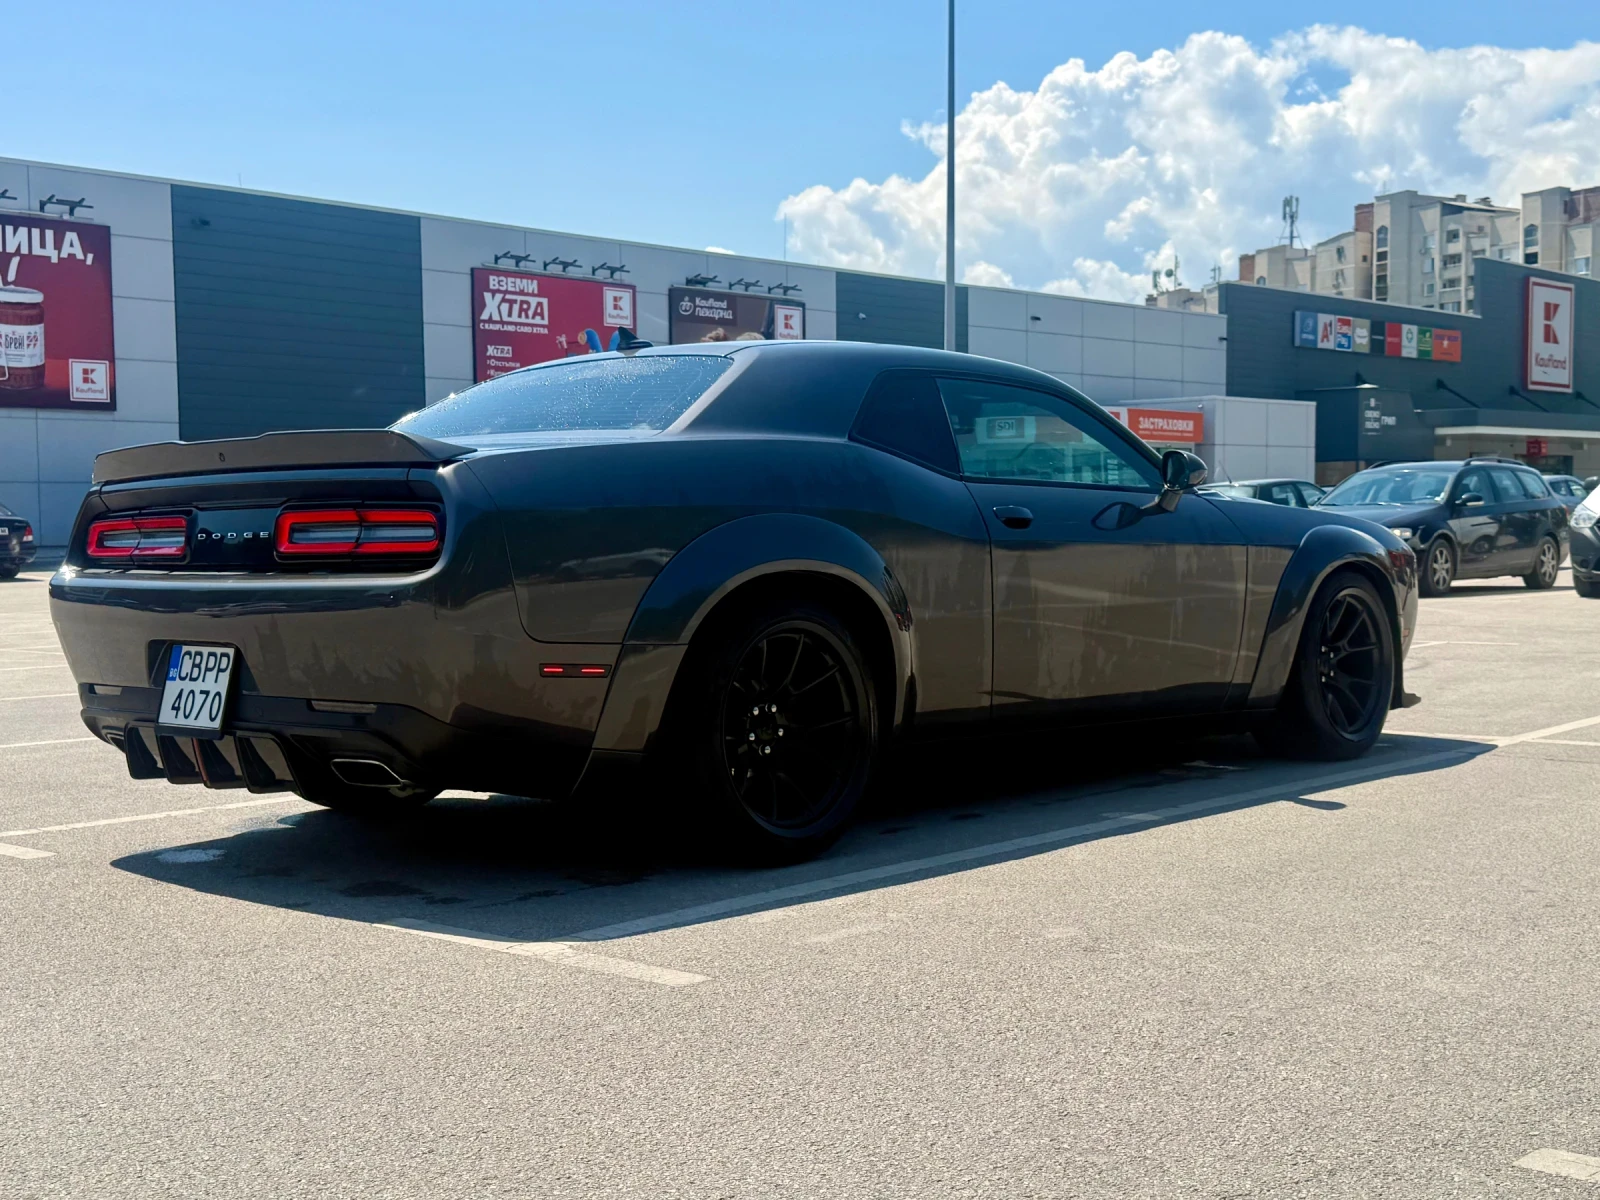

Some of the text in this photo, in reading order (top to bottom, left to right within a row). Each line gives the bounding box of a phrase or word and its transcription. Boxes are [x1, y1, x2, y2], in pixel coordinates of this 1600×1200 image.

[0, 224, 94, 265] ИЦА,
[489, 275, 538, 294] ВЗЕМИ
[480, 292, 548, 325] XTRA
[695, 297, 727, 309] Kaufland
[485, 323, 516, 332] KAUFLAND
[1320, 319, 1333, 343] A1
[486, 345, 513, 357] XTRA
[1535, 352, 1567, 370] Kaufland
[1138, 417, 1194, 431] ЗАСТРАХОВКИ
[197, 531, 269, 540] DODGE
[169, 668, 178, 677] BG
[178, 650, 231, 683] CBPP
[171, 688, 222, 722] 4070
